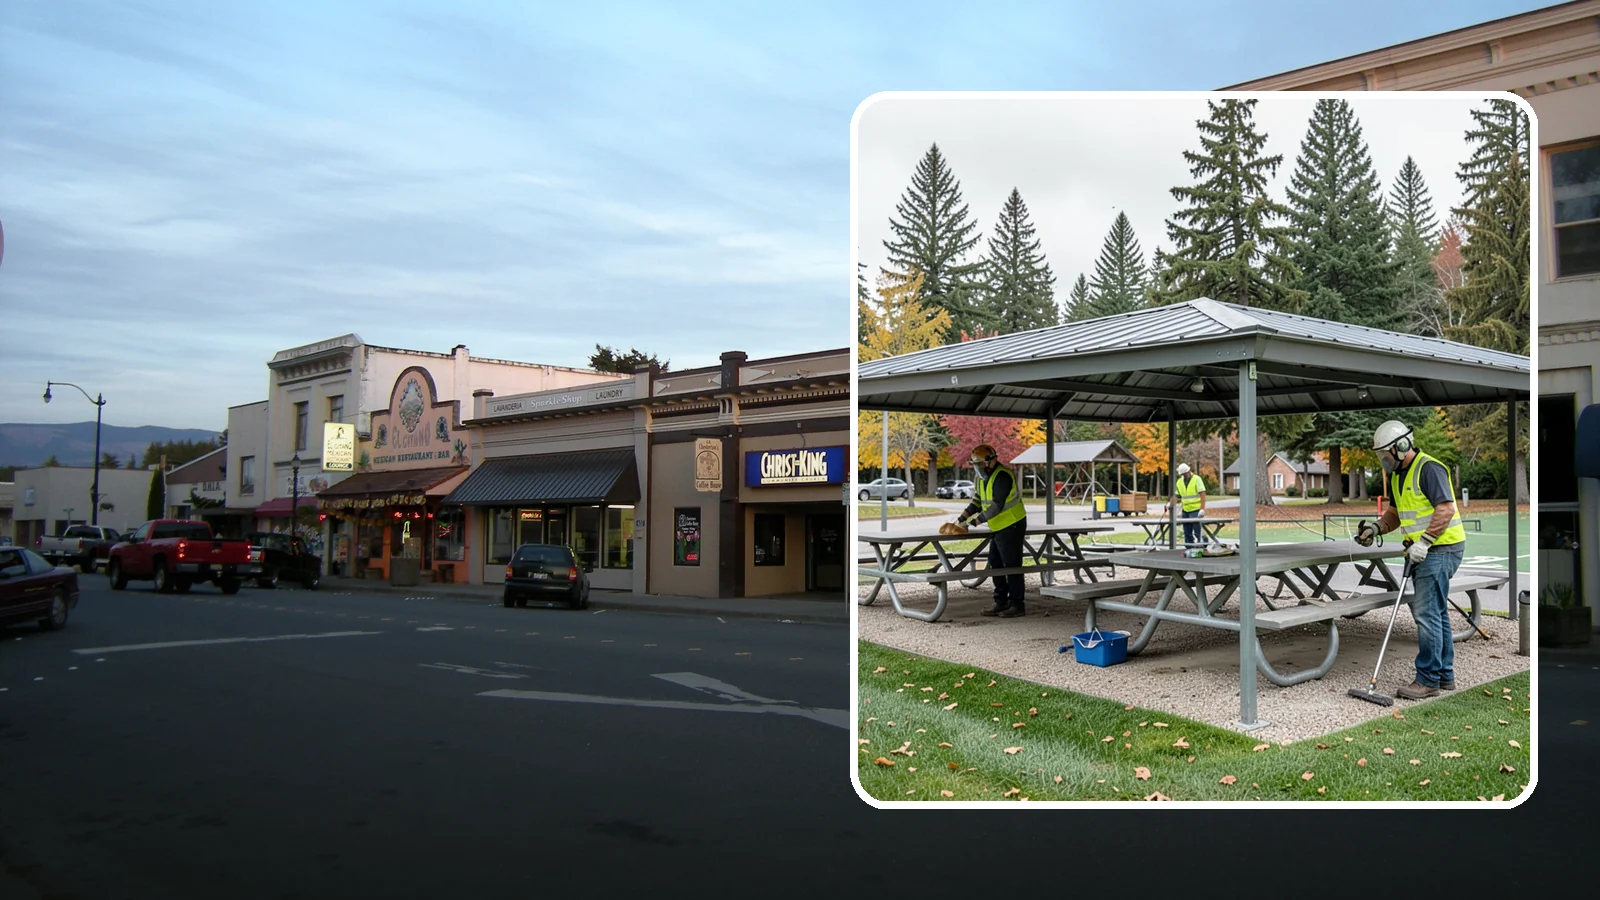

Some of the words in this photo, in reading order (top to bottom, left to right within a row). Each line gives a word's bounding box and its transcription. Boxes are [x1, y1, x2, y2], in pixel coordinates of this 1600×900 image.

[596, 389, 623, 400] LAUNDRY
[494, 402, 523, 412] LAVANDERIA
[531, 396, 562, 409] Sparkle
[562, 394, 583, 405] Shop
[374, 455, 396, 465] MEXICAN
[397, 452, 434, 463] RESTAURANT
[438, 450, 450, 460] BAR
